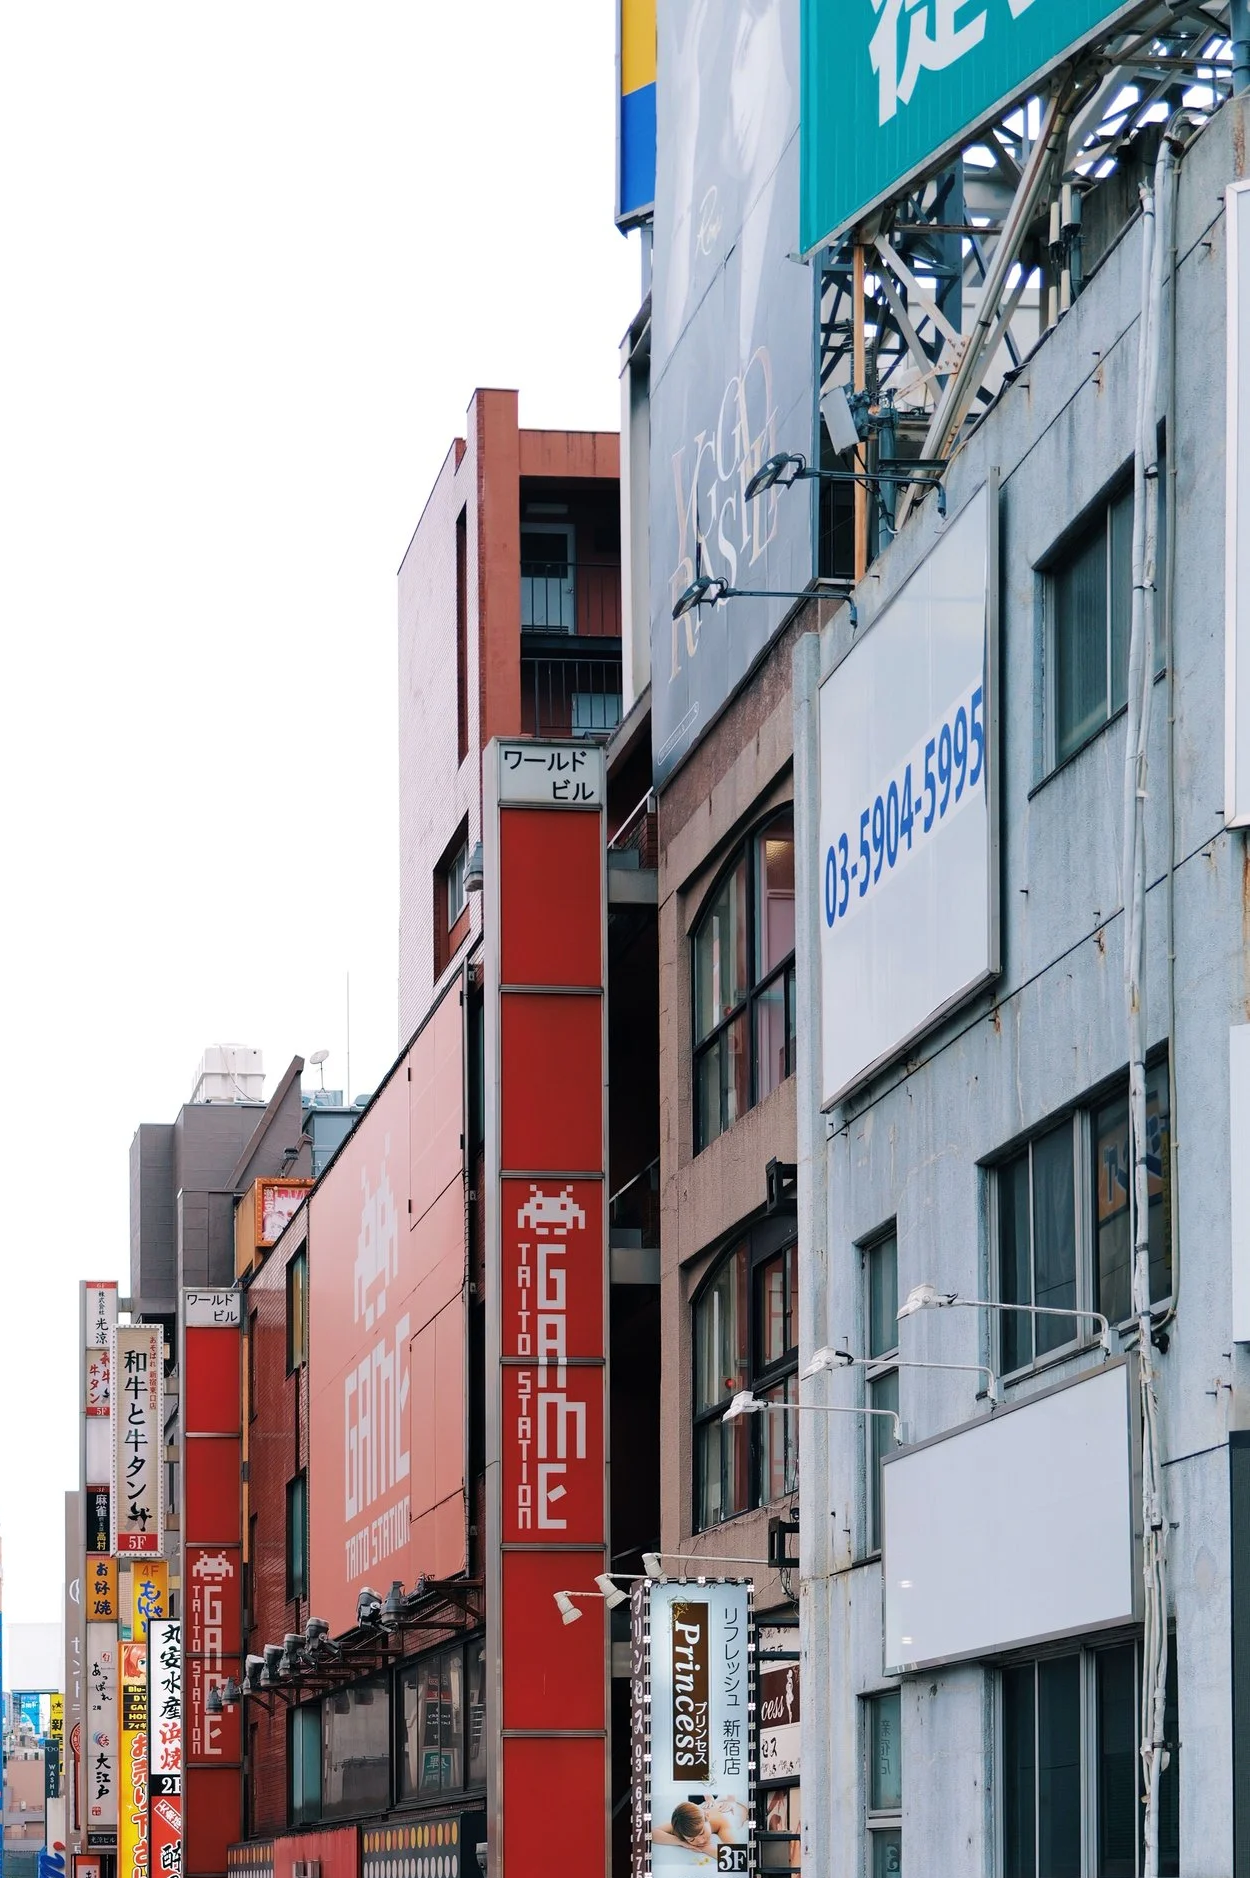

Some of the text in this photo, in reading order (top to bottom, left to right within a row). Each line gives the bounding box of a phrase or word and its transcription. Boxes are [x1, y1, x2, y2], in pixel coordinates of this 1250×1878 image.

[503, 749, 587, 772] ワールド
[551, 778, 595, 802] ビル
[823, 684, 984, 929] 03-5904-5995
[186, 1294, 234, 1306] ワールド
[213, 1311, 238, 1323] ビル
[89, 1364, 100, 1404] 牛タン
[517, 1242, 531, 1530] TAITO STATION
[537, 1243, 587, 1530] GAME
[96, 1407, 108, 1415] 5F
[123, 1349, 149, 1500] 和牛と牛タン
[344, 1312, 411, 1523] GAME
[95, 1494, 108, 1517] 麻雀
[96, 1532, 107, 1550] 高村
[128, 1536, 147, 1550] 5F
[344, 1495, 411, 1583] TAITO STATION
[93, 1562, 112, 1616] お好焼
[141, 1565, 160, 1578] 4F
[193, 1585, 201, 1755] TAITO STATION
[632, 1587, 644, 1737] プリンセス
[675, 1620, 701, 1768] Princess
[722, 1607, 741, 1776] リフレッシュ 新宿店
[695, 1701, 708, 1765] プリンセス
[95, 1752, 111, 1800] 大江戸
[718, 1845, 747, 1872] 3F
